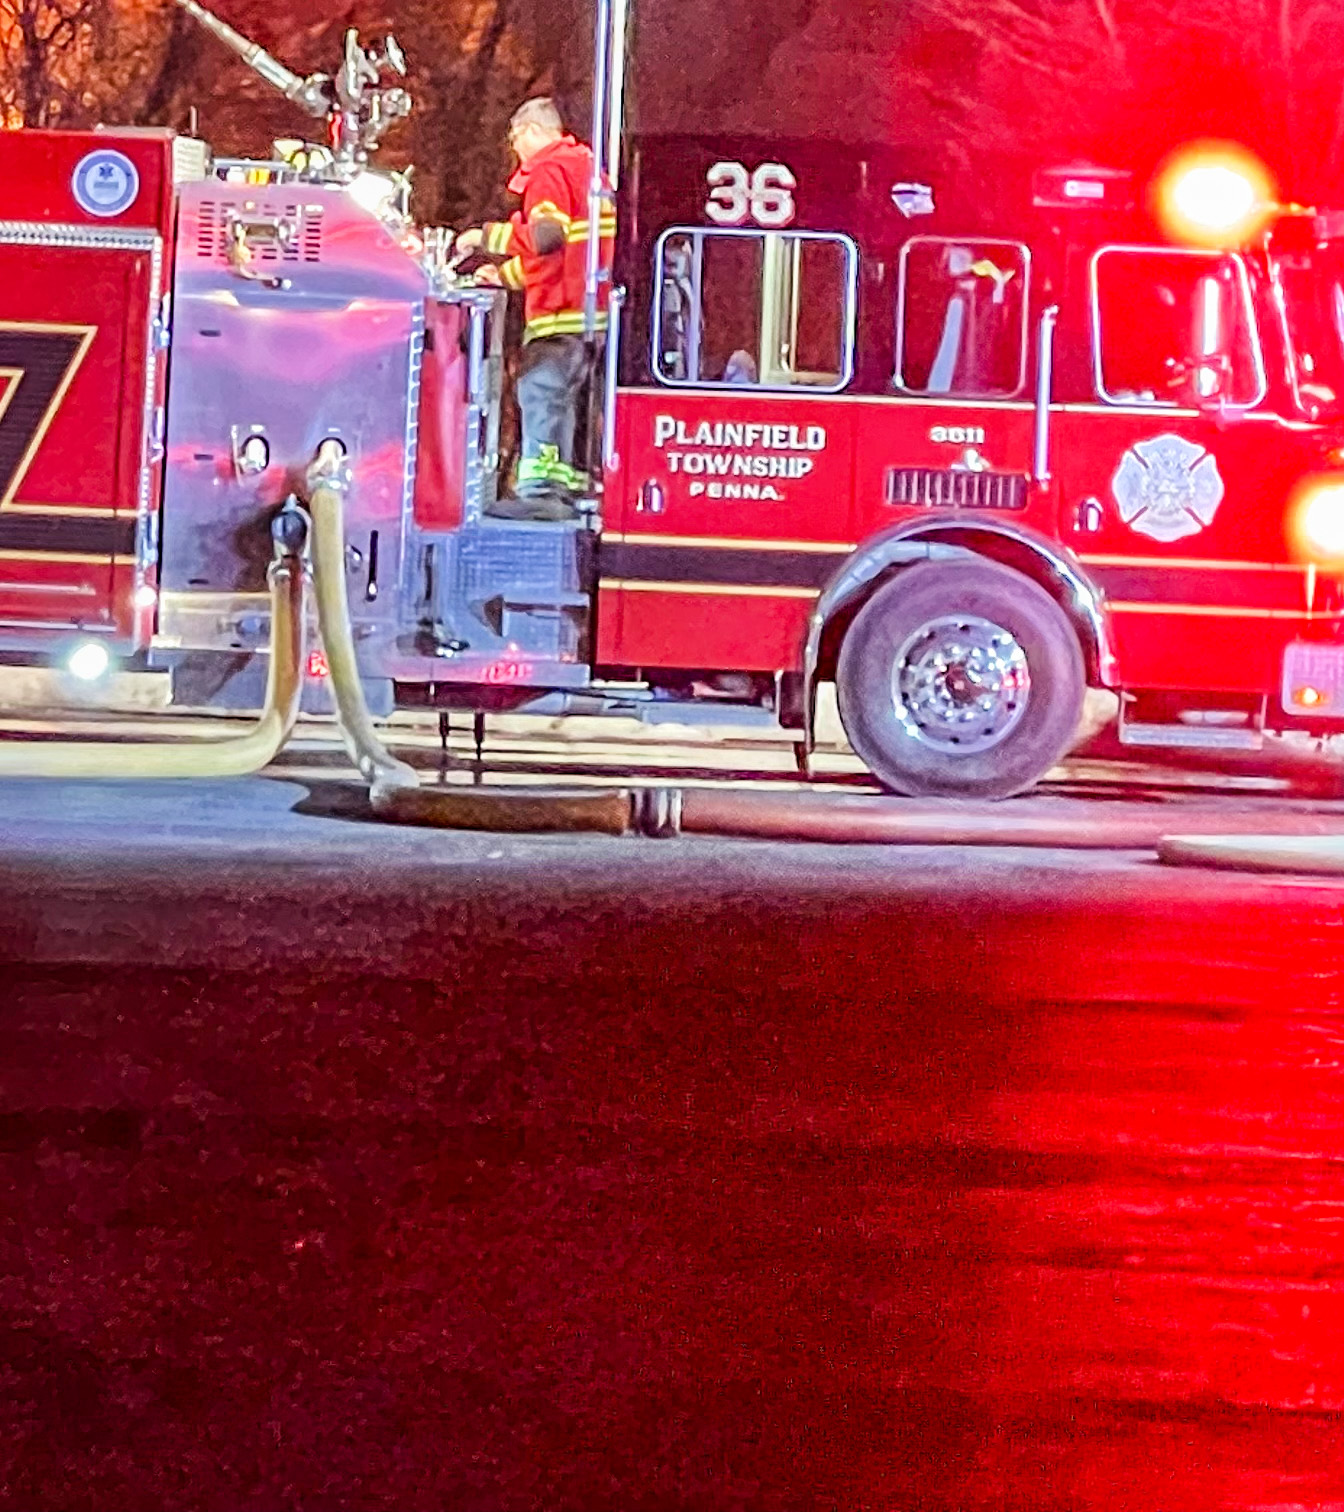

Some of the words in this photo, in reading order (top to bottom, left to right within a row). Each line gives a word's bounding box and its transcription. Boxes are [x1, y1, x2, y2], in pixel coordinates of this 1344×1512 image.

[705, 161, 797, 227] 36
[654, 414, 826, 451] PLAINFIELD
[666, 451, 814, 479] TOWNSHIP
[688, 481, 786, 502] PENNA.
